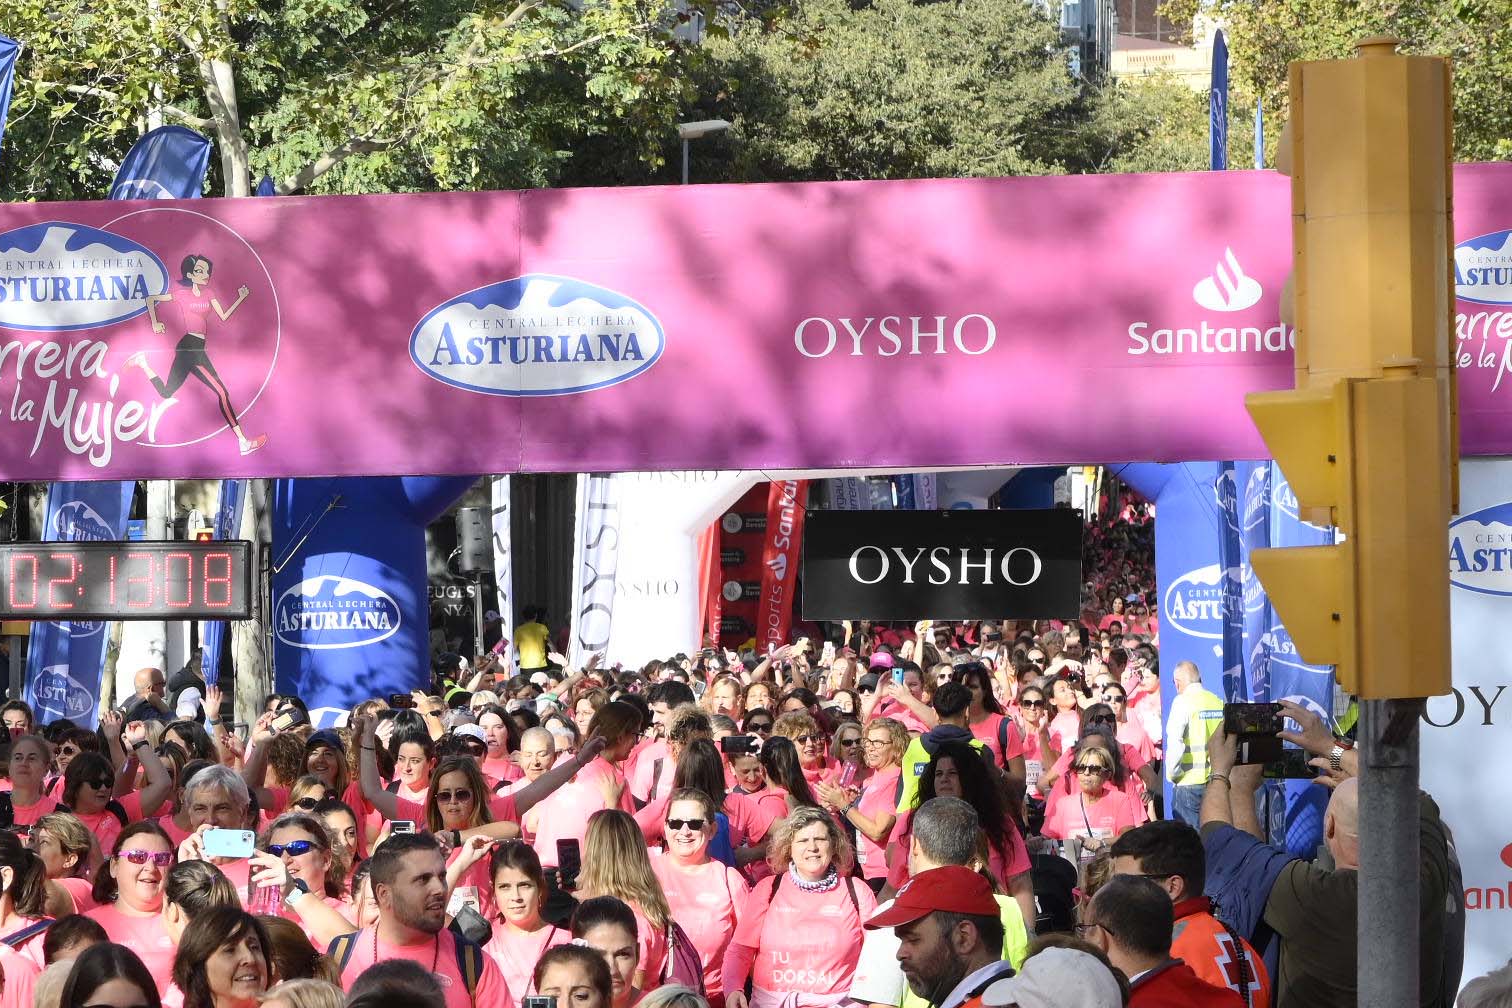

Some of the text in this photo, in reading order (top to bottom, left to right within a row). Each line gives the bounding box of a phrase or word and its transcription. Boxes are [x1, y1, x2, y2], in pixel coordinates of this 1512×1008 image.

[72, 256, 144, 271] LECHERA
[469, 315, 637, 330] CENTRAL LECHERA
[794, 313, 997, 359] OYSHO
[429, 322, 645, 367] ASTURIANA
[10, 383, 35, 422] la
[30, 378, 180, 468] Mujer
[848, 545, 1042, 586] OYSHO
[278, 605, 392, 632] ASTURIANA
[291, 599, 387, 610] CENTRAL LECHERA
